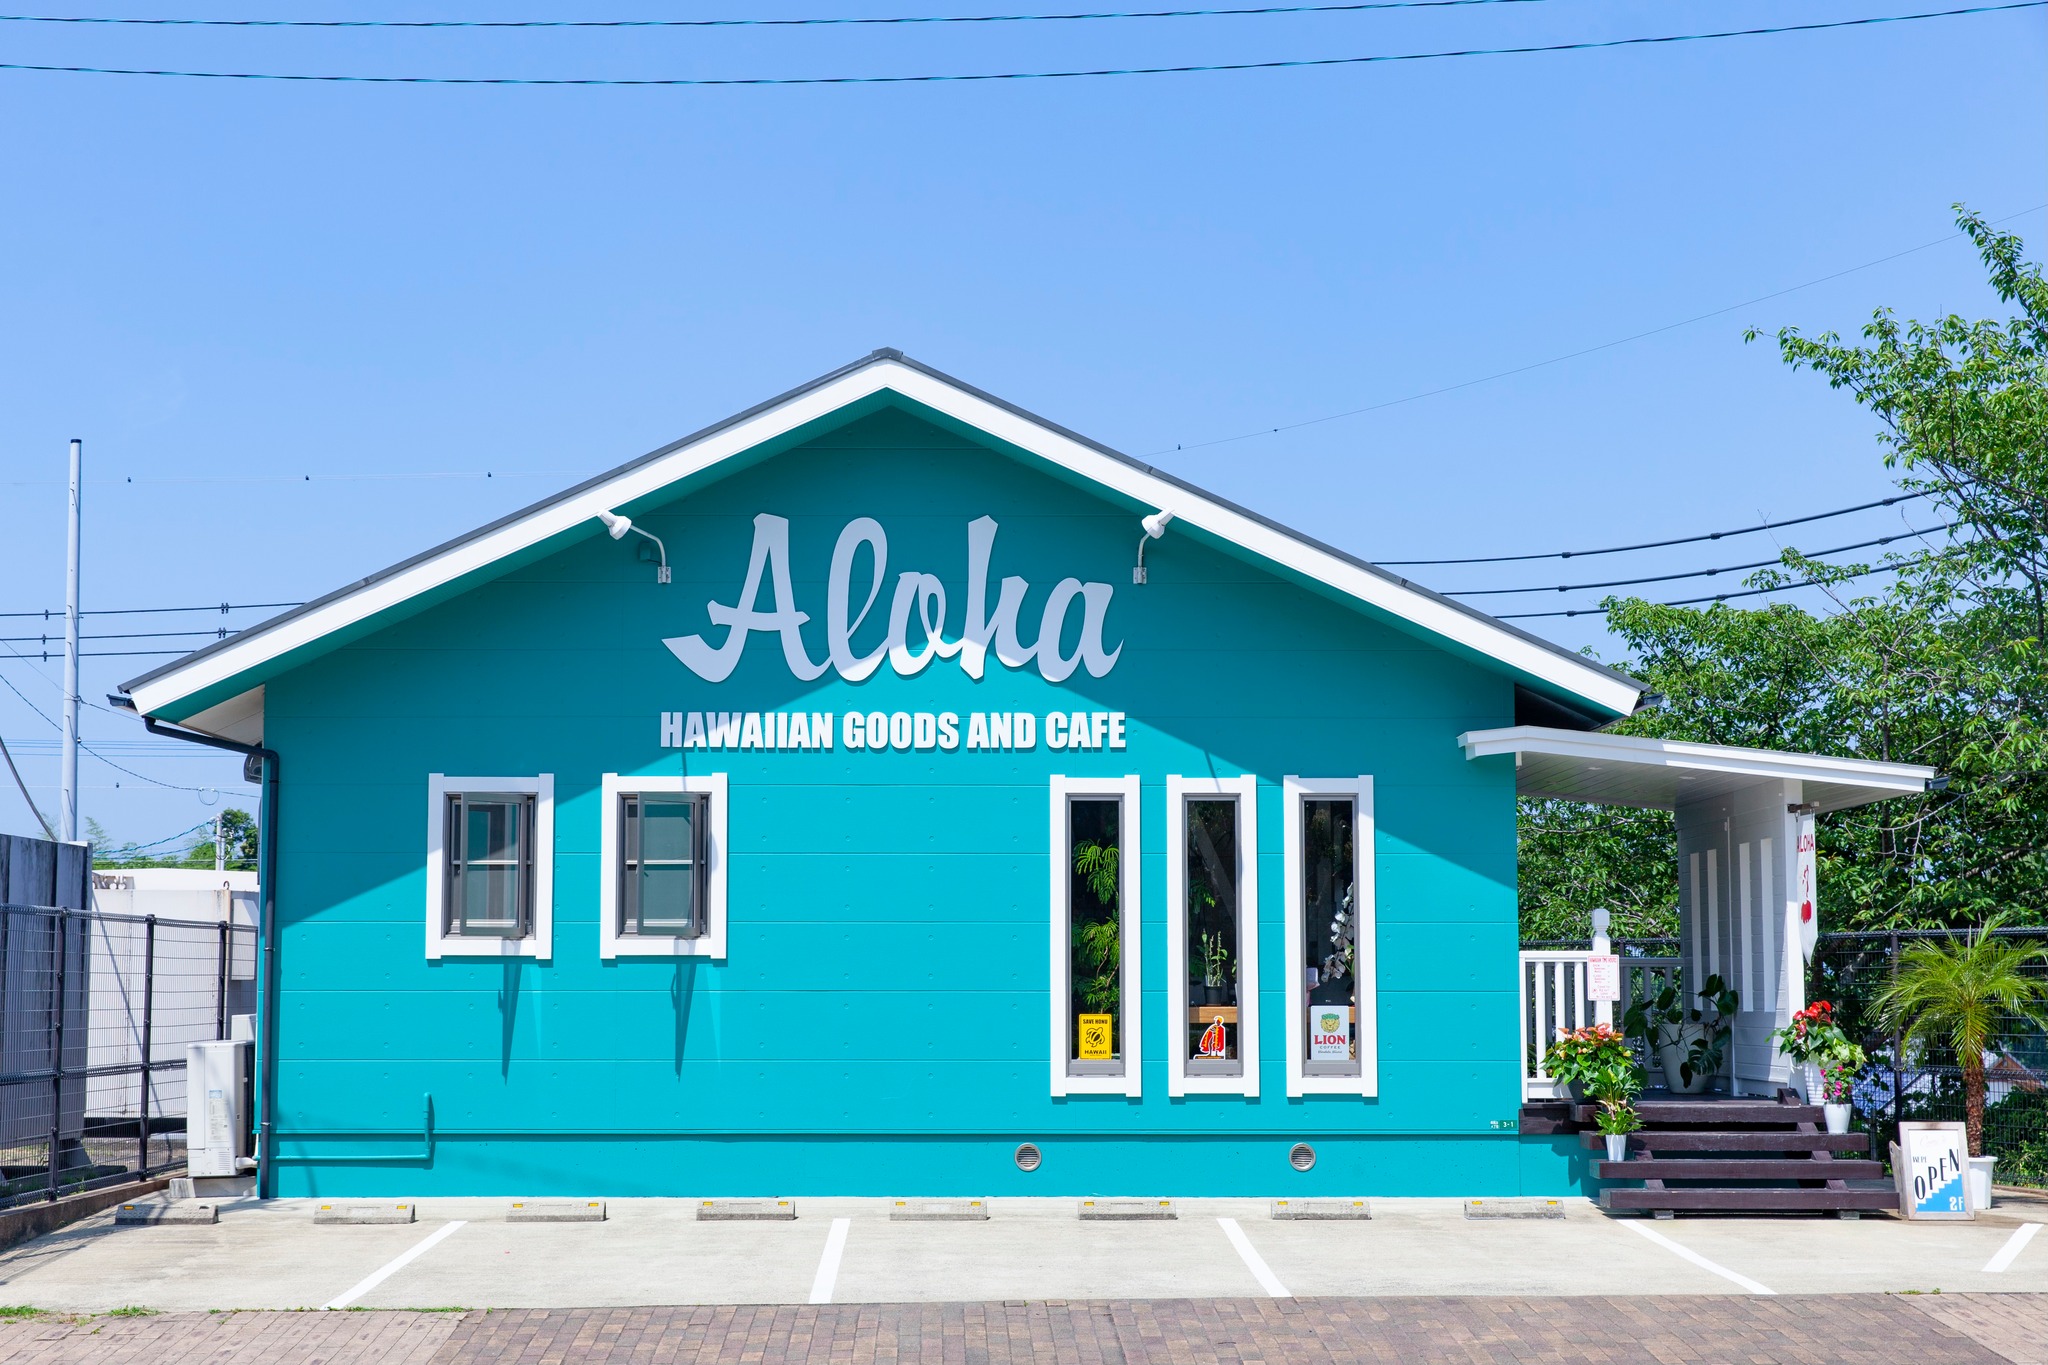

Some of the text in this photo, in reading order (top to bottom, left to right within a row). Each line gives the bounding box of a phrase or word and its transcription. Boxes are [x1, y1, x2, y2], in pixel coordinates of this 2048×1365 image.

[661, 513, 1124, 683] Aloha
[660, 711, 1127, 749] HAWAIIAN GOODS AND CAFE
[1796, 833, 1815, 853] ALOHA
[1314, 1034, 1347, 1045] LION
[1914, 1148, 1960, 1200] OPEN
[1949, 1196, 1964, 1211] 2F
